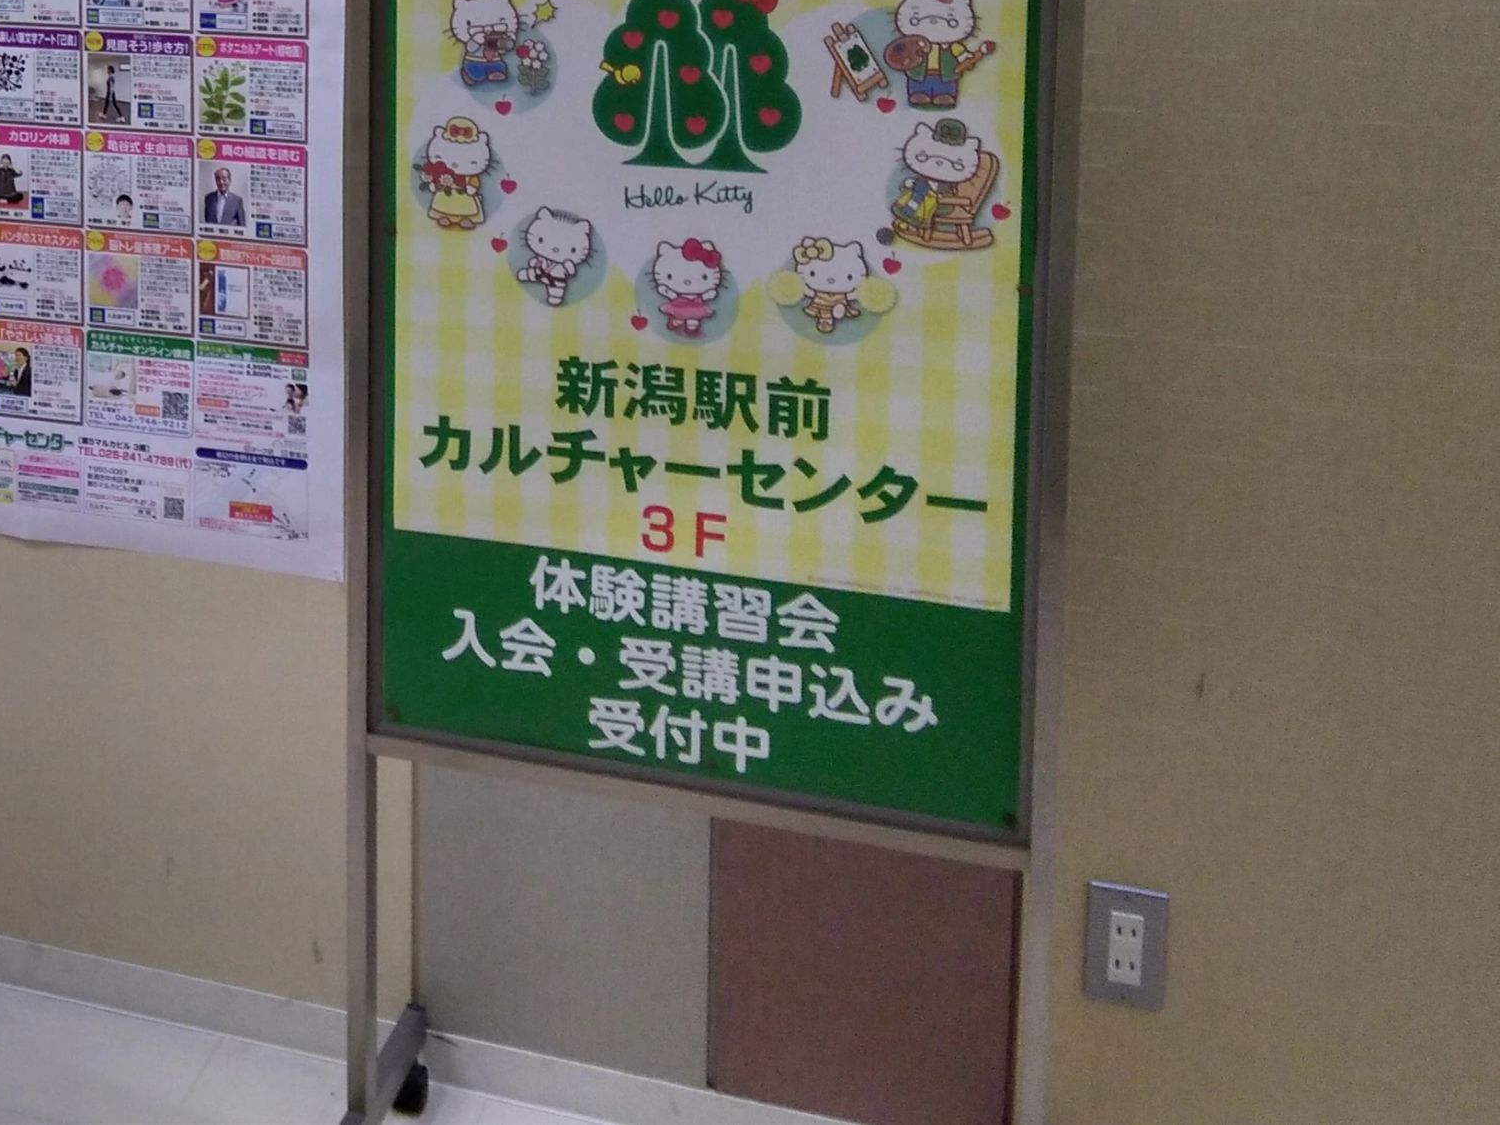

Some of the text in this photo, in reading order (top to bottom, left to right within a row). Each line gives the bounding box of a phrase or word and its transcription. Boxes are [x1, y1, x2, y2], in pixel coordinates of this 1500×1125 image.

[624, 182, 755, 213] Hello Kitty
[555, 356, 832, 441] 新潟駅前
[419, 416, 988, 524] カルチャーセンター
[530, 554, 841, 655] 体験講習会
[443, 609, 939, 734] 入会・受講申込み
[588, 697, 772, 773] 受付中
